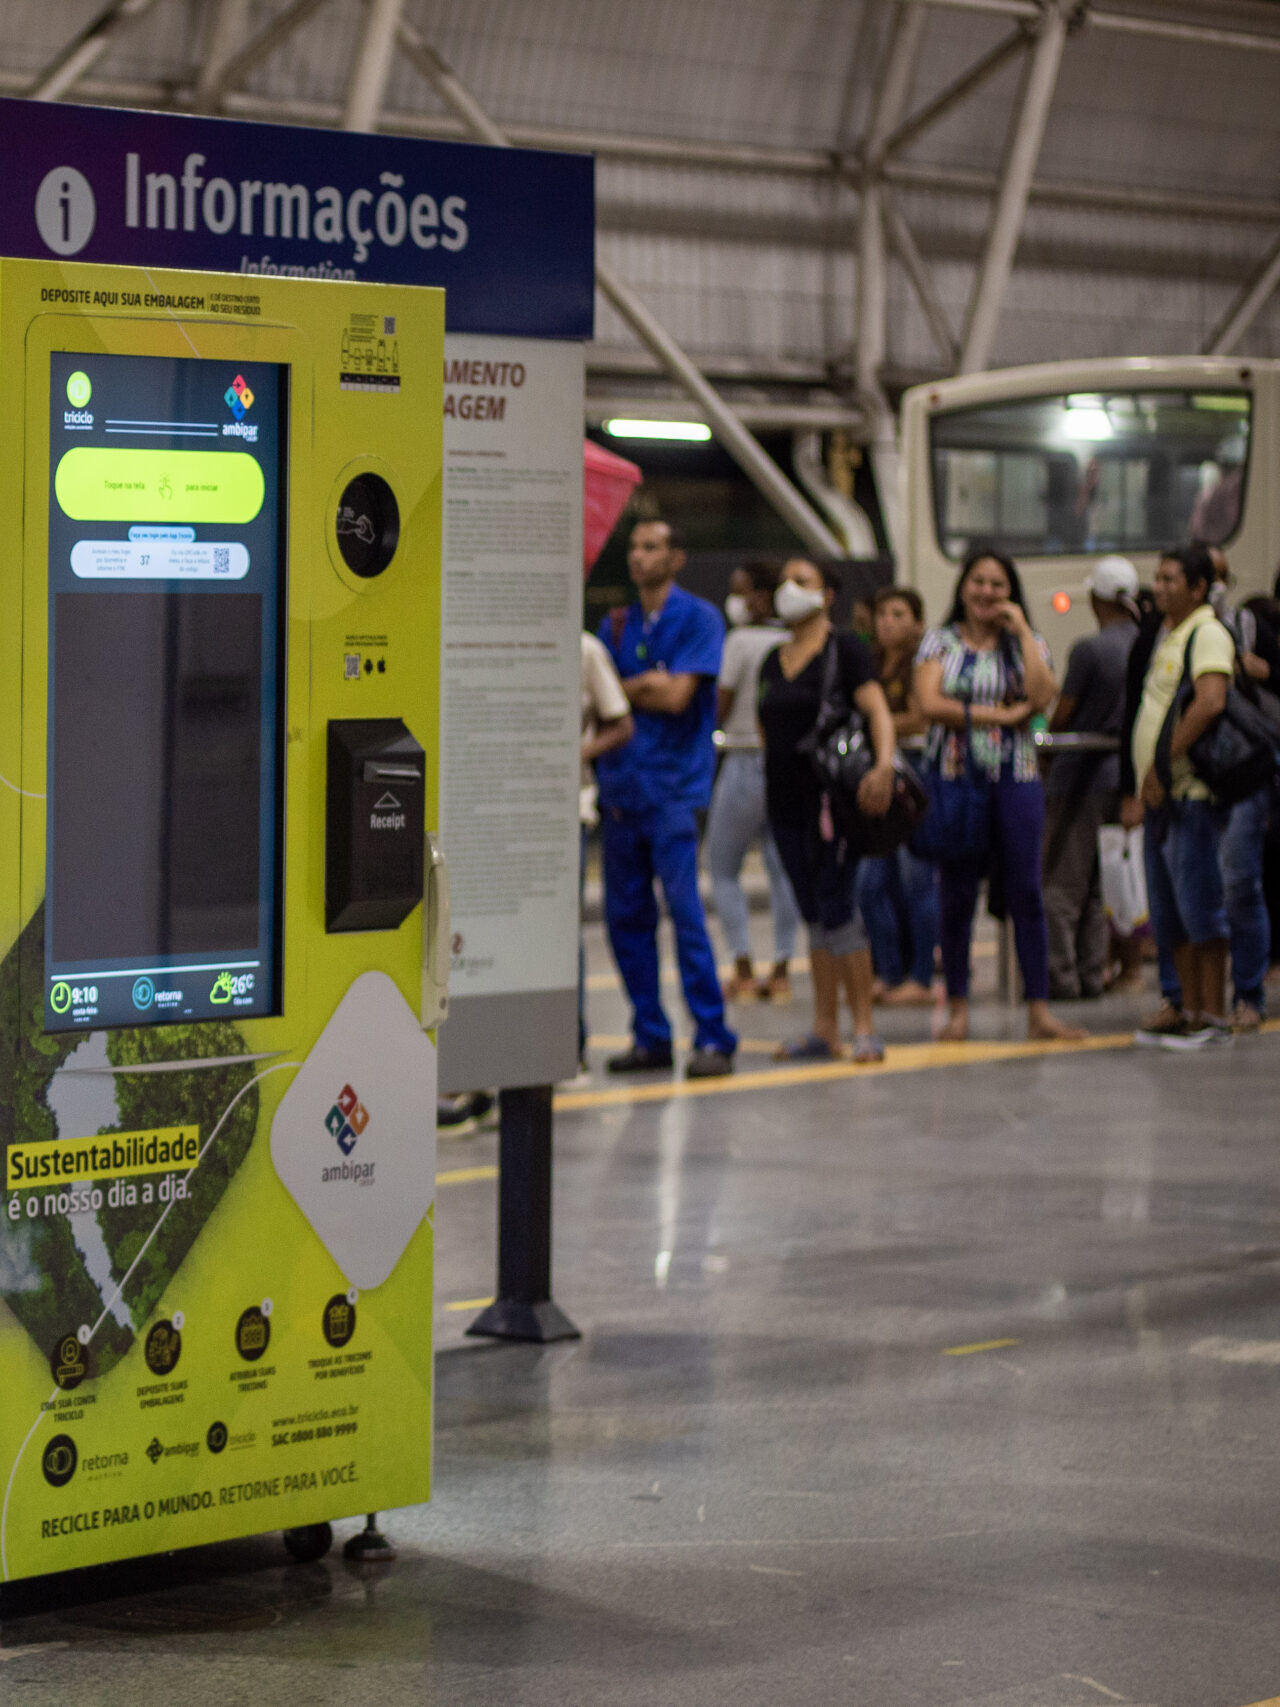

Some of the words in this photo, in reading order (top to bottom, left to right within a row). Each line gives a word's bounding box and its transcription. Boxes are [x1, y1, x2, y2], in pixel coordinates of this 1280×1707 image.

[125, 152, 468, 262] Informações
[41, 288, 90, 304] DEPOSITE
[93, 290, 118, 307] AQUI
[121, 292, 141, 306] SUA
[144, 293, 205, 309] EMBALAGEM
[64, 411, 94, 424] triciclo
[222, 422, 259, 438] ambipar
[370, 813, 406, 830] Receipt
[71, 985, 99, 1004] 9:10
[154, 990, 183, 1002] retorna
[10, 1133, 198, 1180] Sustentabilidade
[321, 1160, 376, 1182] ambipar
[8, 1191, 21, 1220] é
[26, 1198, 39, 1219] o
[43, 1188, 103, 1216] nosso
[107, 1180, 137, 1208] dia
[141, 1182, 154, 1204] a
[158, 1173, 193, 1202] dia.
[81, 1451, 129, 1472] retorna
[41, 1510, 100, 1538] RECICLE
[103, 1502, 141, 1528] PARA
[143, 1503, 155, 1520] O
[157, 1490, 216, 1517] MUNDO.
[219, 1477, 281, 1506] RETORNE
[283, 1471, 318, 1493] PARA
